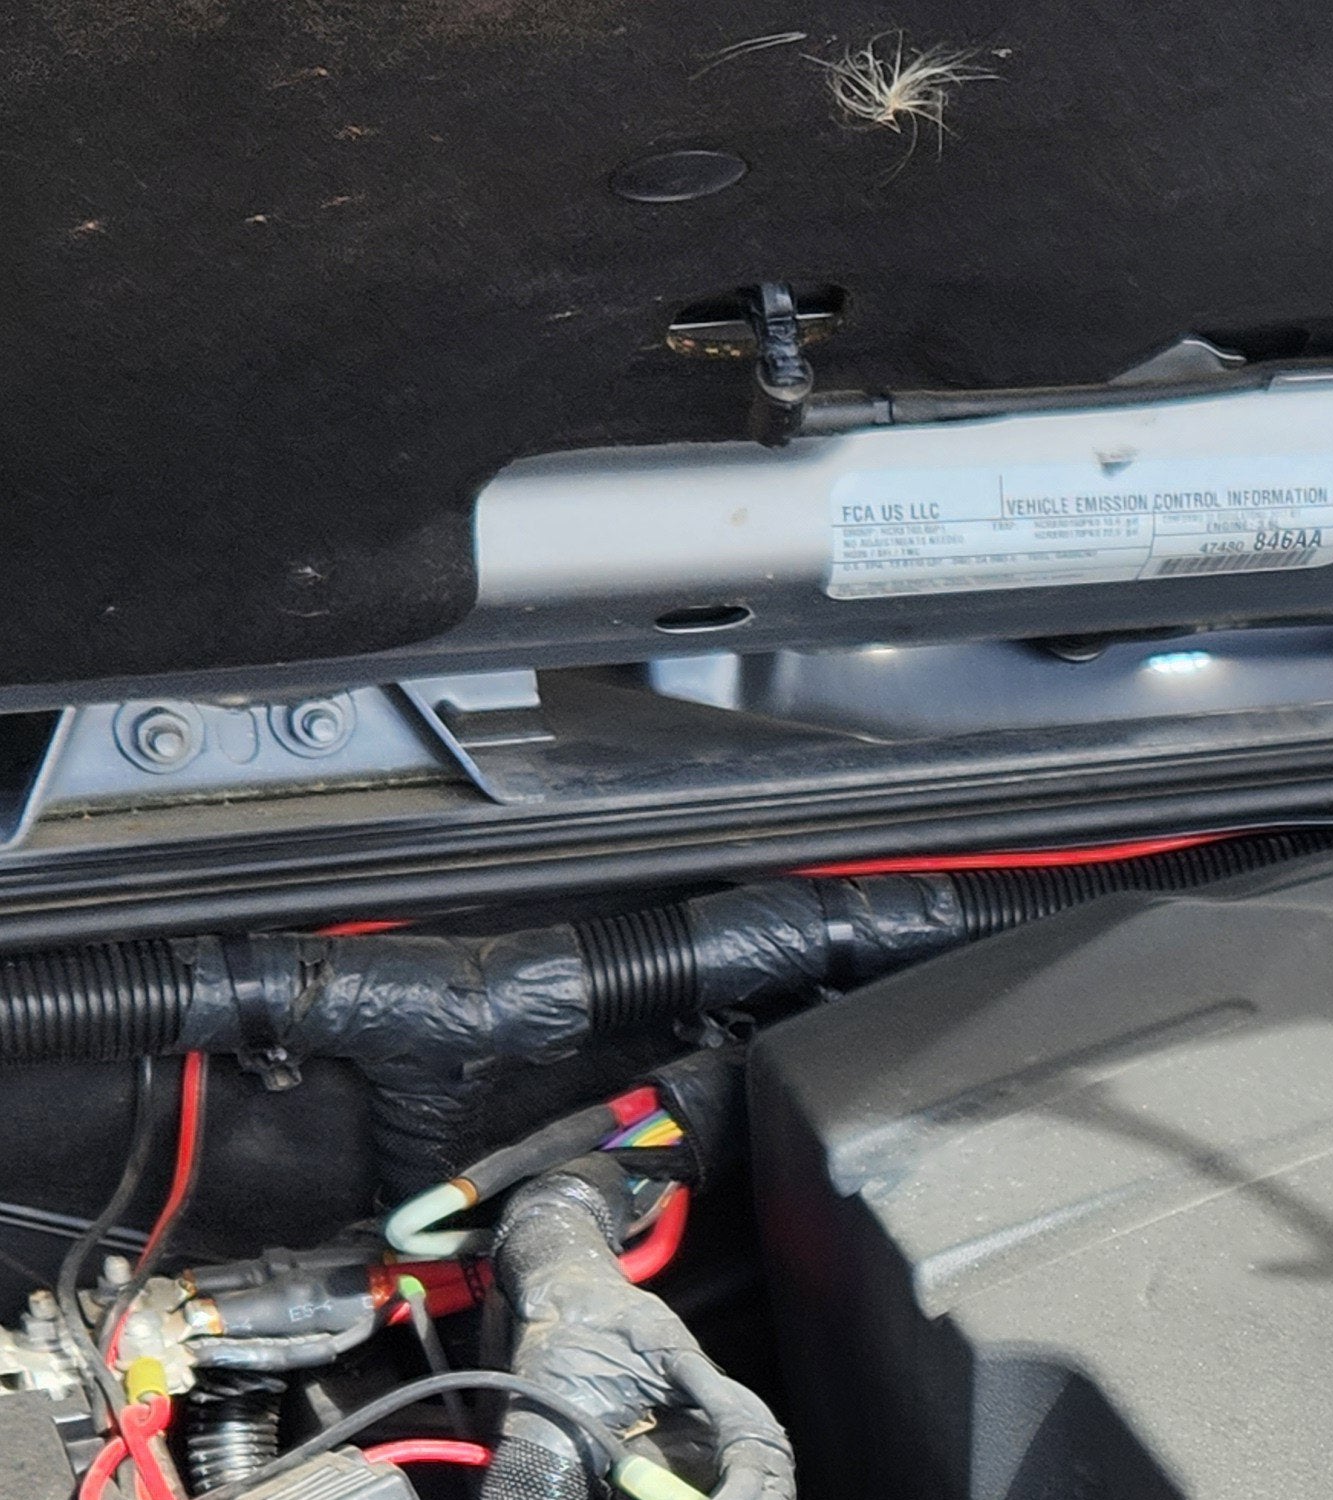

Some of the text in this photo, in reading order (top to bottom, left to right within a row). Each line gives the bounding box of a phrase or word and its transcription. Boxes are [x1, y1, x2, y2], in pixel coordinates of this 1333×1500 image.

[842, 502, 940, 522] FCA US LLC
[1006, 498, 1069, 516] VEHICLE
[1075, 493, 1148, 514] EMISSION
[1153, 491, 1221, 510] CONTROL
[1227, 487, 1328, 506] INFORMATION
[1253, 530, 1322, 551] 846AA
